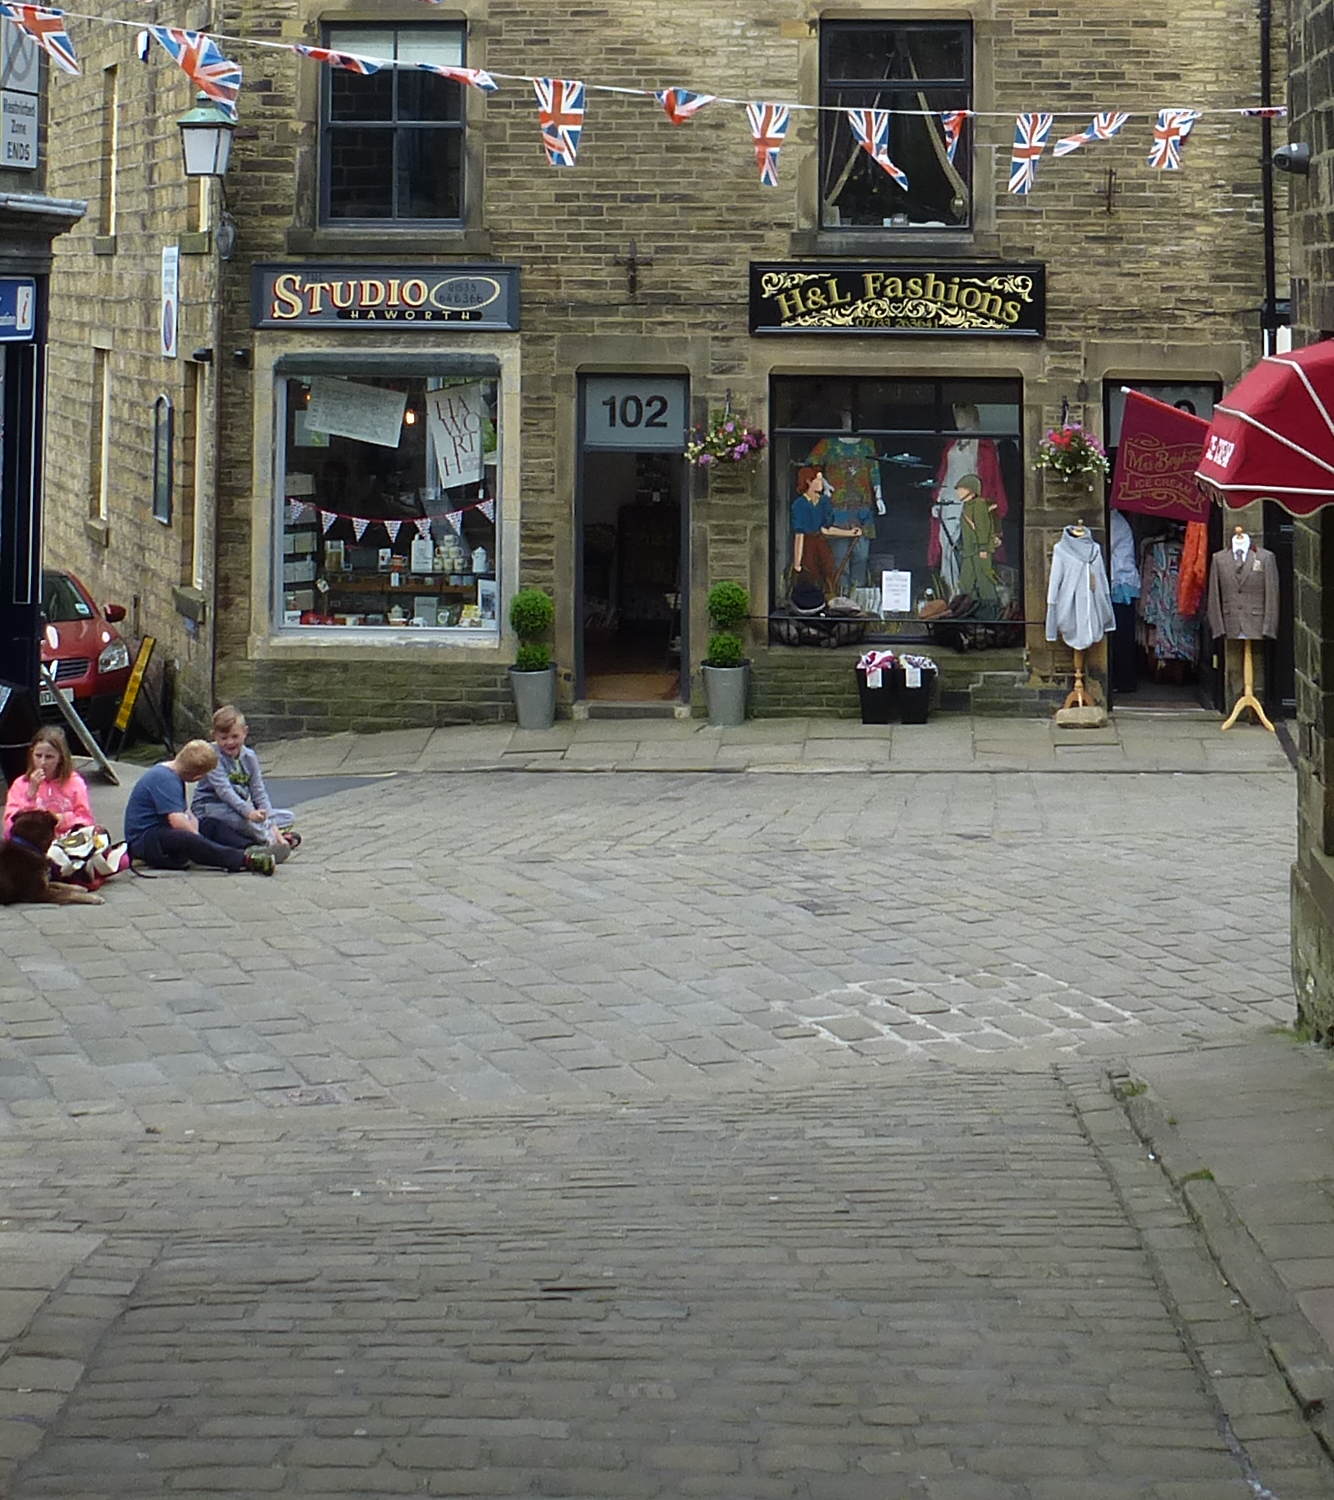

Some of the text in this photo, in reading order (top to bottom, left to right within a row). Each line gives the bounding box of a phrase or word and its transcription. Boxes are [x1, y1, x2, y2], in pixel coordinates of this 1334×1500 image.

[7, 141, 30, 161] ENDS
[272, 273, 429, 320] STUDIO
[448, 283, 477, 293] 01535
[775, 272, 1022, 324] H&L Fashions
[350, 310, 471, 320] HAWORTH
[602, 395, 668, 428] 102
[1135, 478, 1193, 495] ICE CREAM
